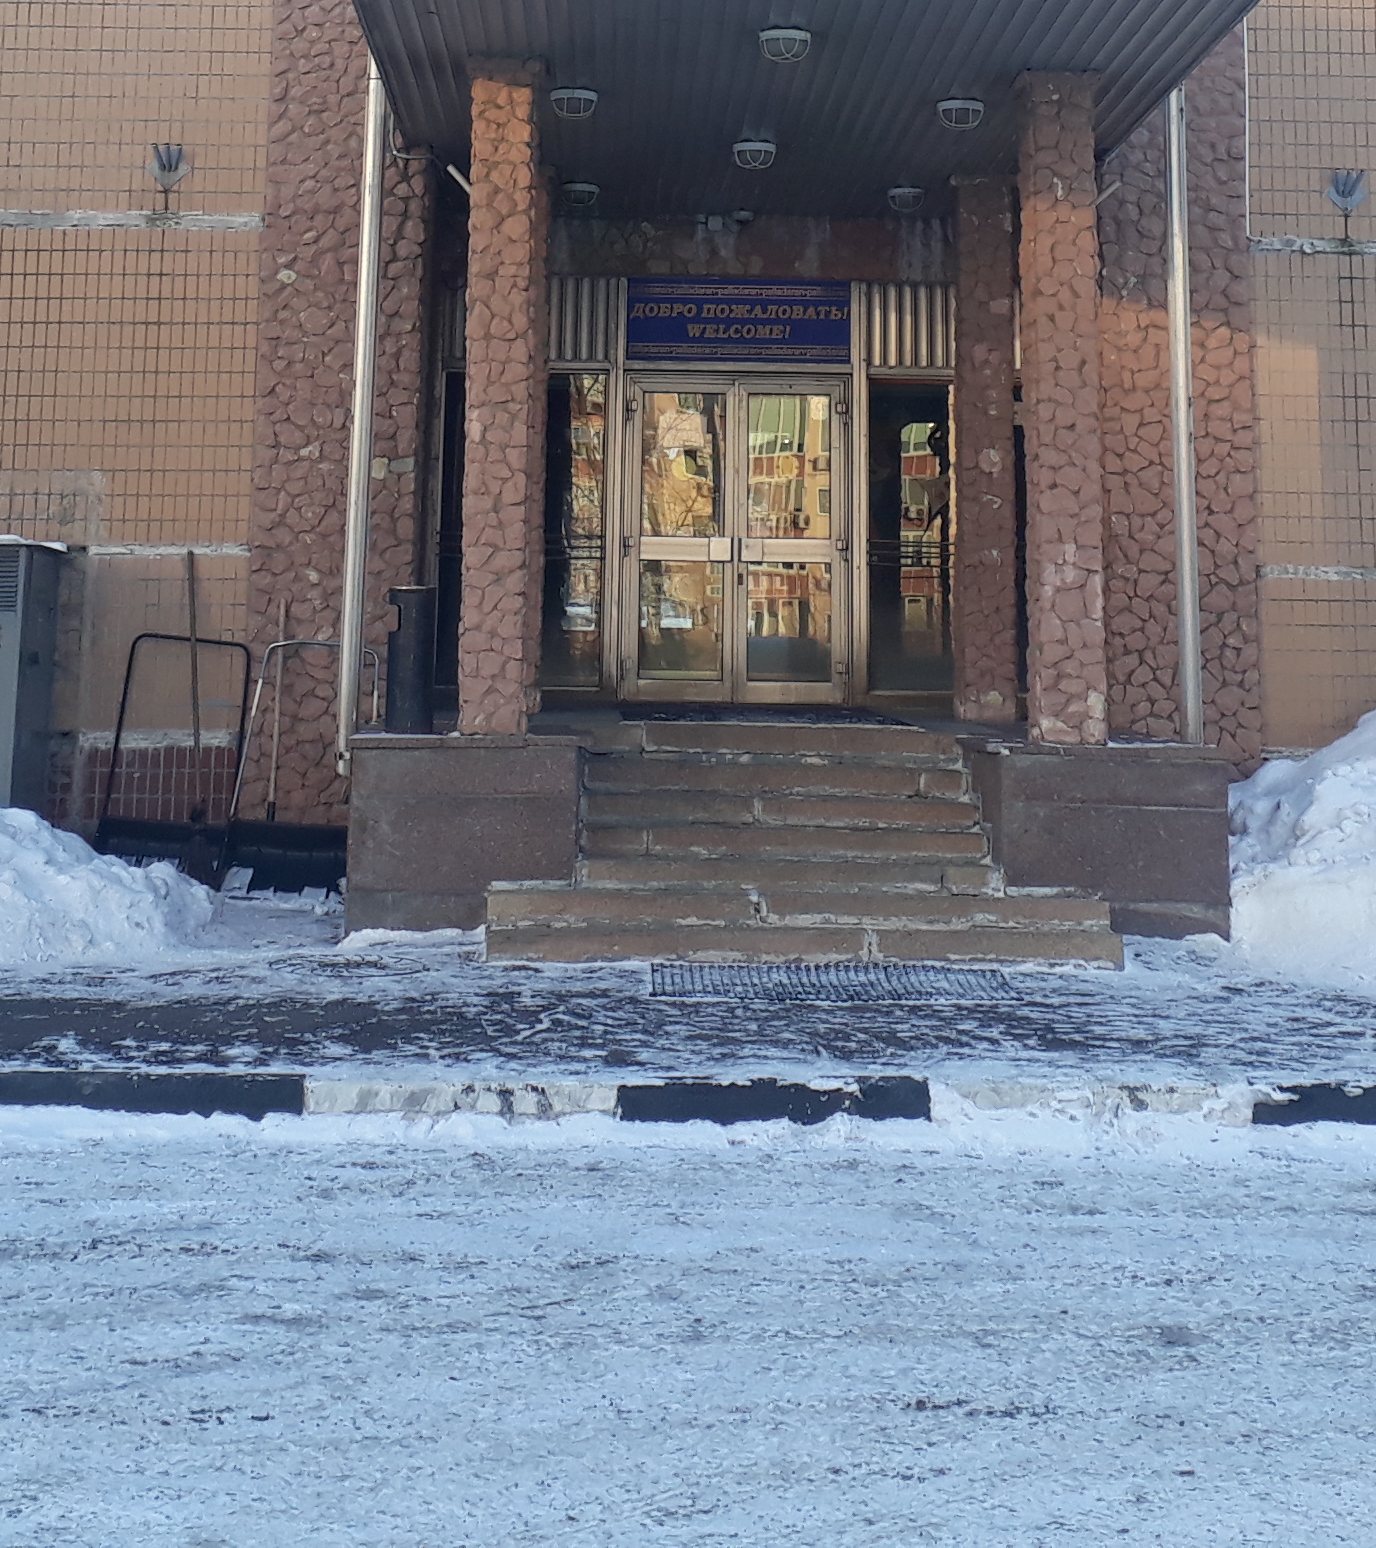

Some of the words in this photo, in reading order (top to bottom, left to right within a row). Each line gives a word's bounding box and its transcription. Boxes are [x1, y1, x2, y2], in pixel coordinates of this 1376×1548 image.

[630, 302, 697, 319] ДОБРО
[701, 303, 849, 320] ПОЖАЛОВАТЬ!
[686, 324, 792, 339] WELCOME!
